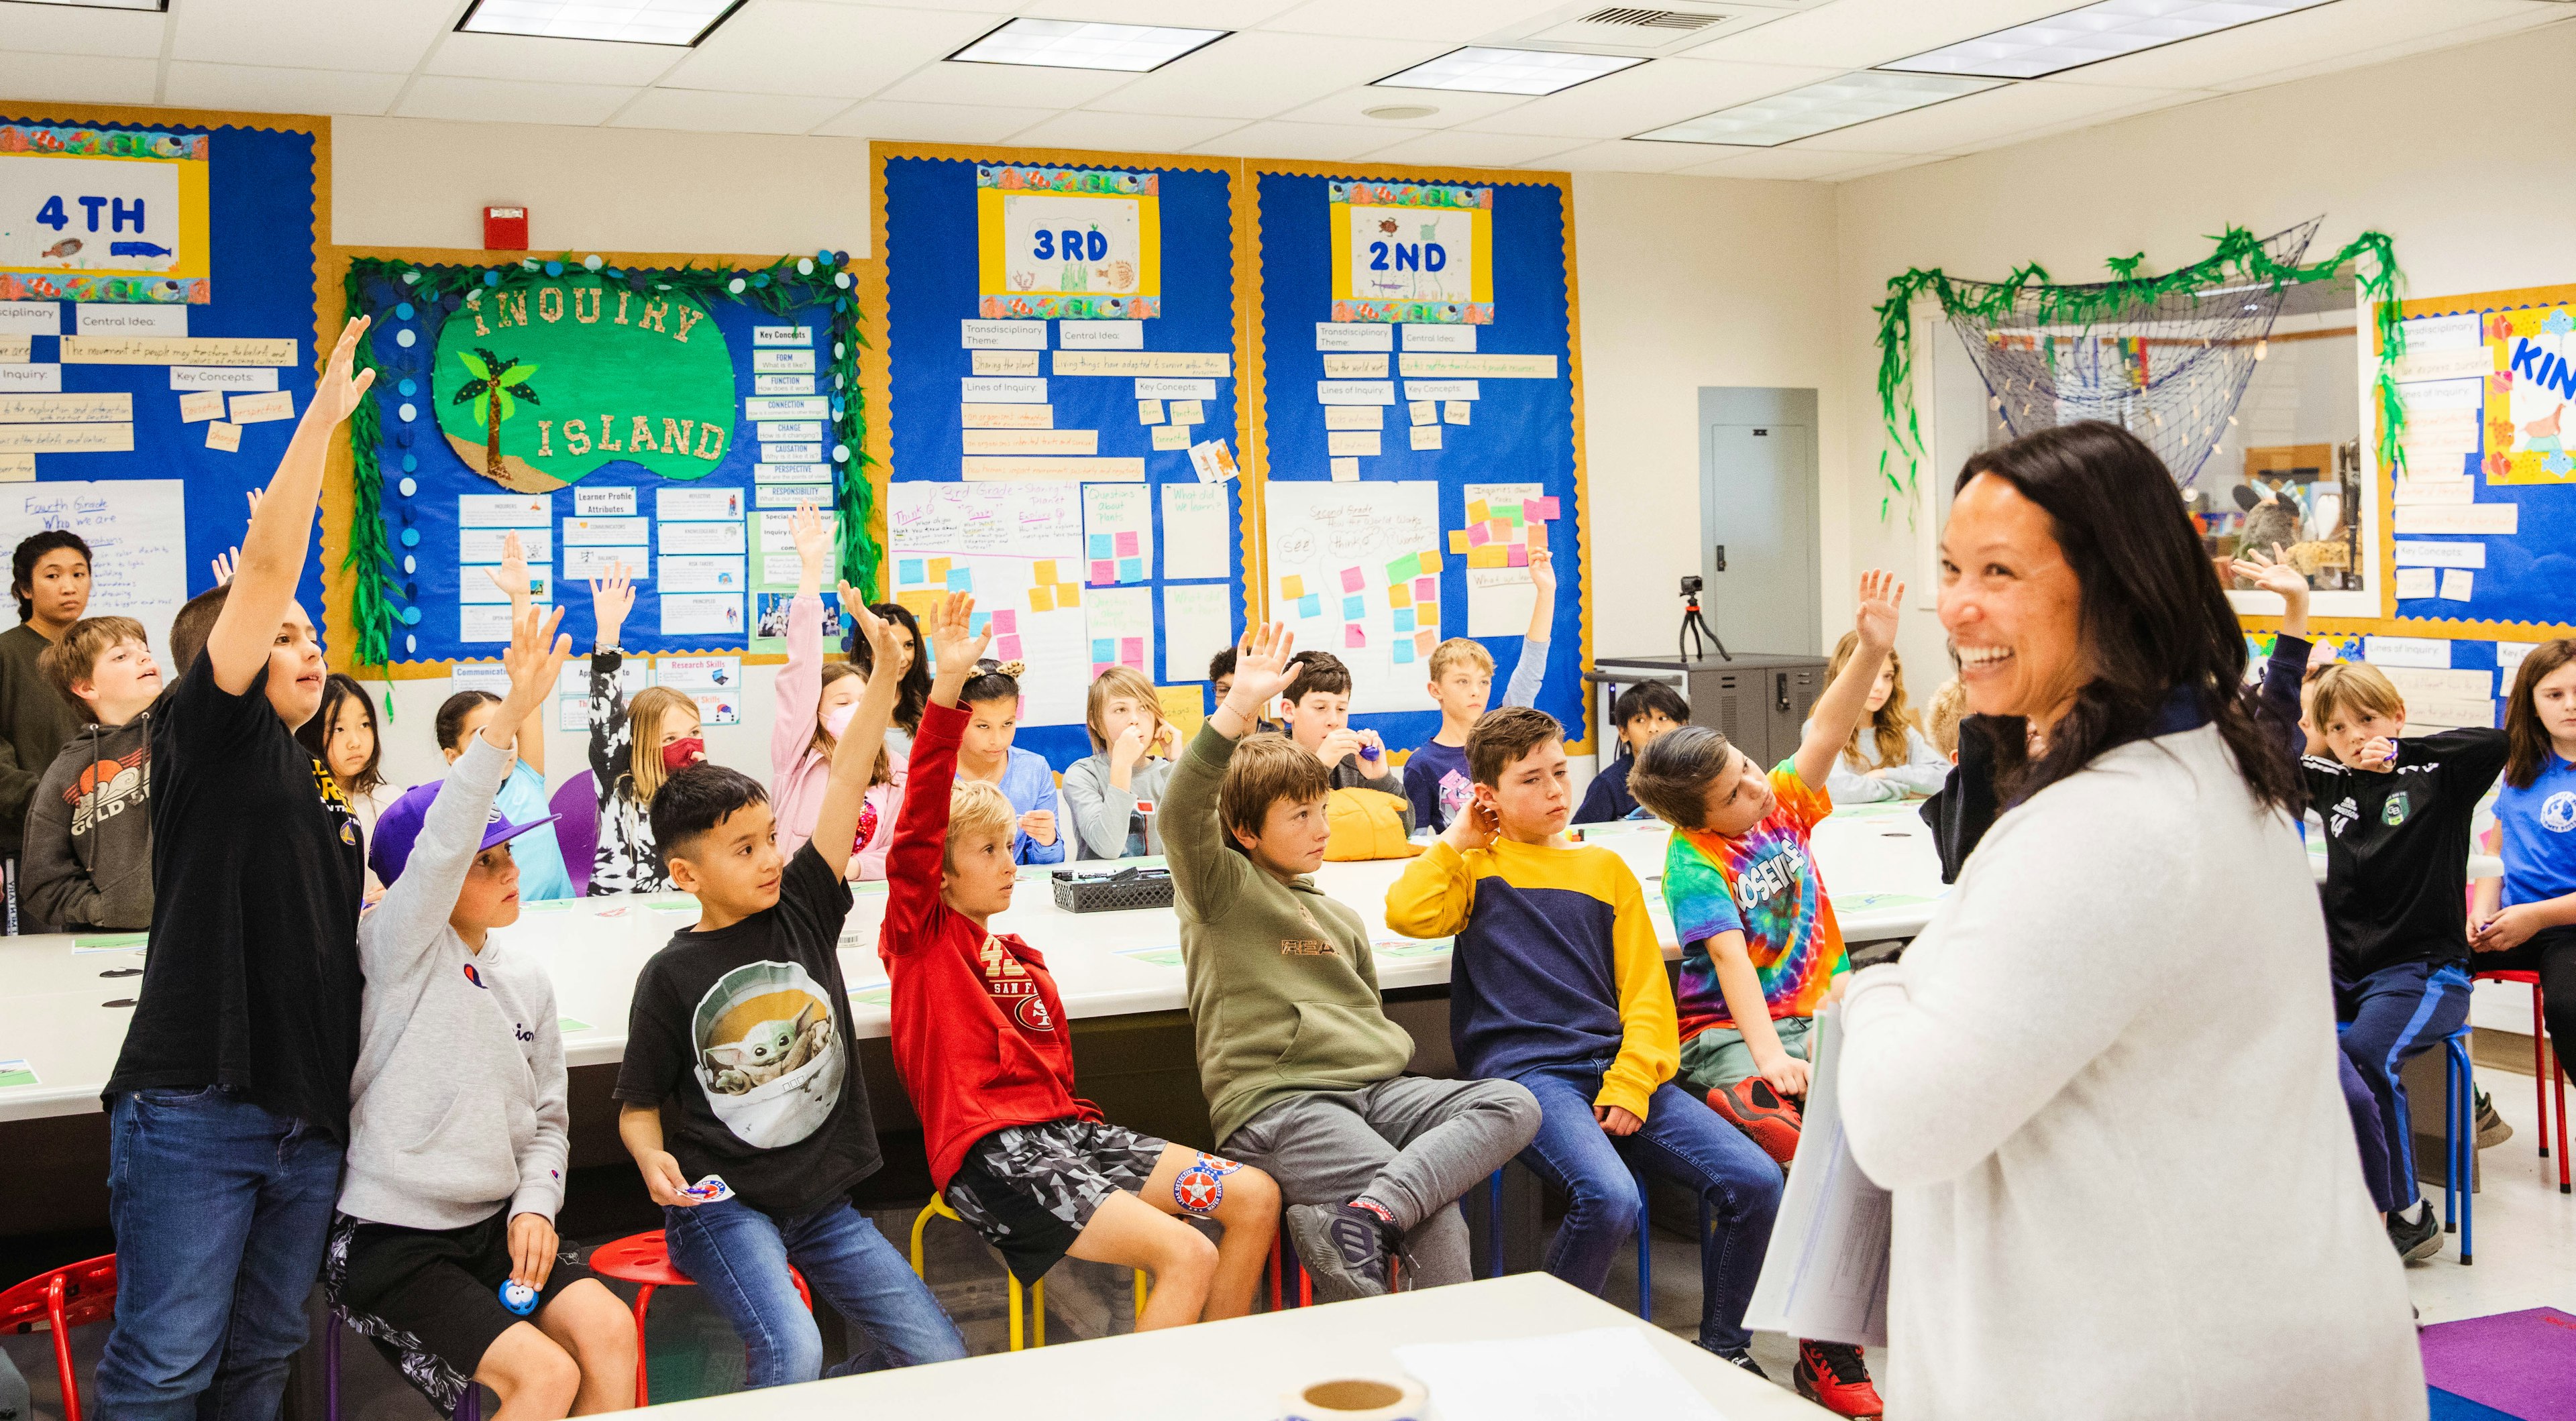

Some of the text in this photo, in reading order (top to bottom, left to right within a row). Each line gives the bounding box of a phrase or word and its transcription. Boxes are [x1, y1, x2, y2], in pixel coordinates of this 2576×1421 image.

[1370, 241, 1446, 272] 2ND
[466, 287, 704, 343] INQUIRY
[83, 317, 156, 326] Central Idea:
[760, 331, 773, 339] Key
[967, 325, 1042, 336] Transdisciplinary
[1321, 328, 1388, 337] Transdisciplinary
[1065, 331, 1120, 340] Central Idea:
[1406, 335, 1455, 343] Central Idea:
[967, 336, 998, 345] Theme:
[1321, 338, 1349, 347] Theme:
[776, 353, 794, 362] FORM
[974, 355, 1035, 372] Sharing the planet
[1054, 355, 1078, 371] Living
[1081, 356, 1101, 372] things
[3, 370, 48, 380] Inquiry:
[177, 372, 254, 383] Key Concepts:
[771, 377, 800, 385] FUNCTION
[967, 383, 1038, 393] Lines of Inquiry:
[1140, 383, 1197, 392] Key Concepts:
[1322, 386, 1385, 395] Lines of Inquiry:
[1409, 385, 1461, 394] Key Concepts:
[768, 401, 804, 409] CONNECTION
[1142, 403, 1159, 417] form
[777, 424, 801, 432] CHANGE
[538, 414, 725, 461] ISLAND
[788, 432, 819, 440] changing?
[775, 445, 808, 453] CAUSATION
[775, 465, 812, 473] PERSPECTIVE
[773, 487, 819, 496] RESPONSIBILITY
[1174, 488, 1214, 500] What did
[579, 492, 633, 501] Learner Profile
[588, 505, 625, 514] Attributes
[894, 504, 922, 524] Think
[43, 514, 117, 530] Who we are
[2400, 545, 2463, 558] Key Concepts:
[2369, 642, 2392, 654] Lines
[2393, 642, 2403, 654] of
[2502, 647, 2518, 659] Key
[671, 660, 725, 669] Research Skills
[623, 669, 630, 677] to
[701, 696, 720, 704] Skills
[2330, 813, 2349, 838] 14
[994, 983, 1018, 993] SAN
[1175, 1168, 1195, 1206] LEAK DETECTIVE
[1206, 1180, 1223, 1211] WATER SAVER
